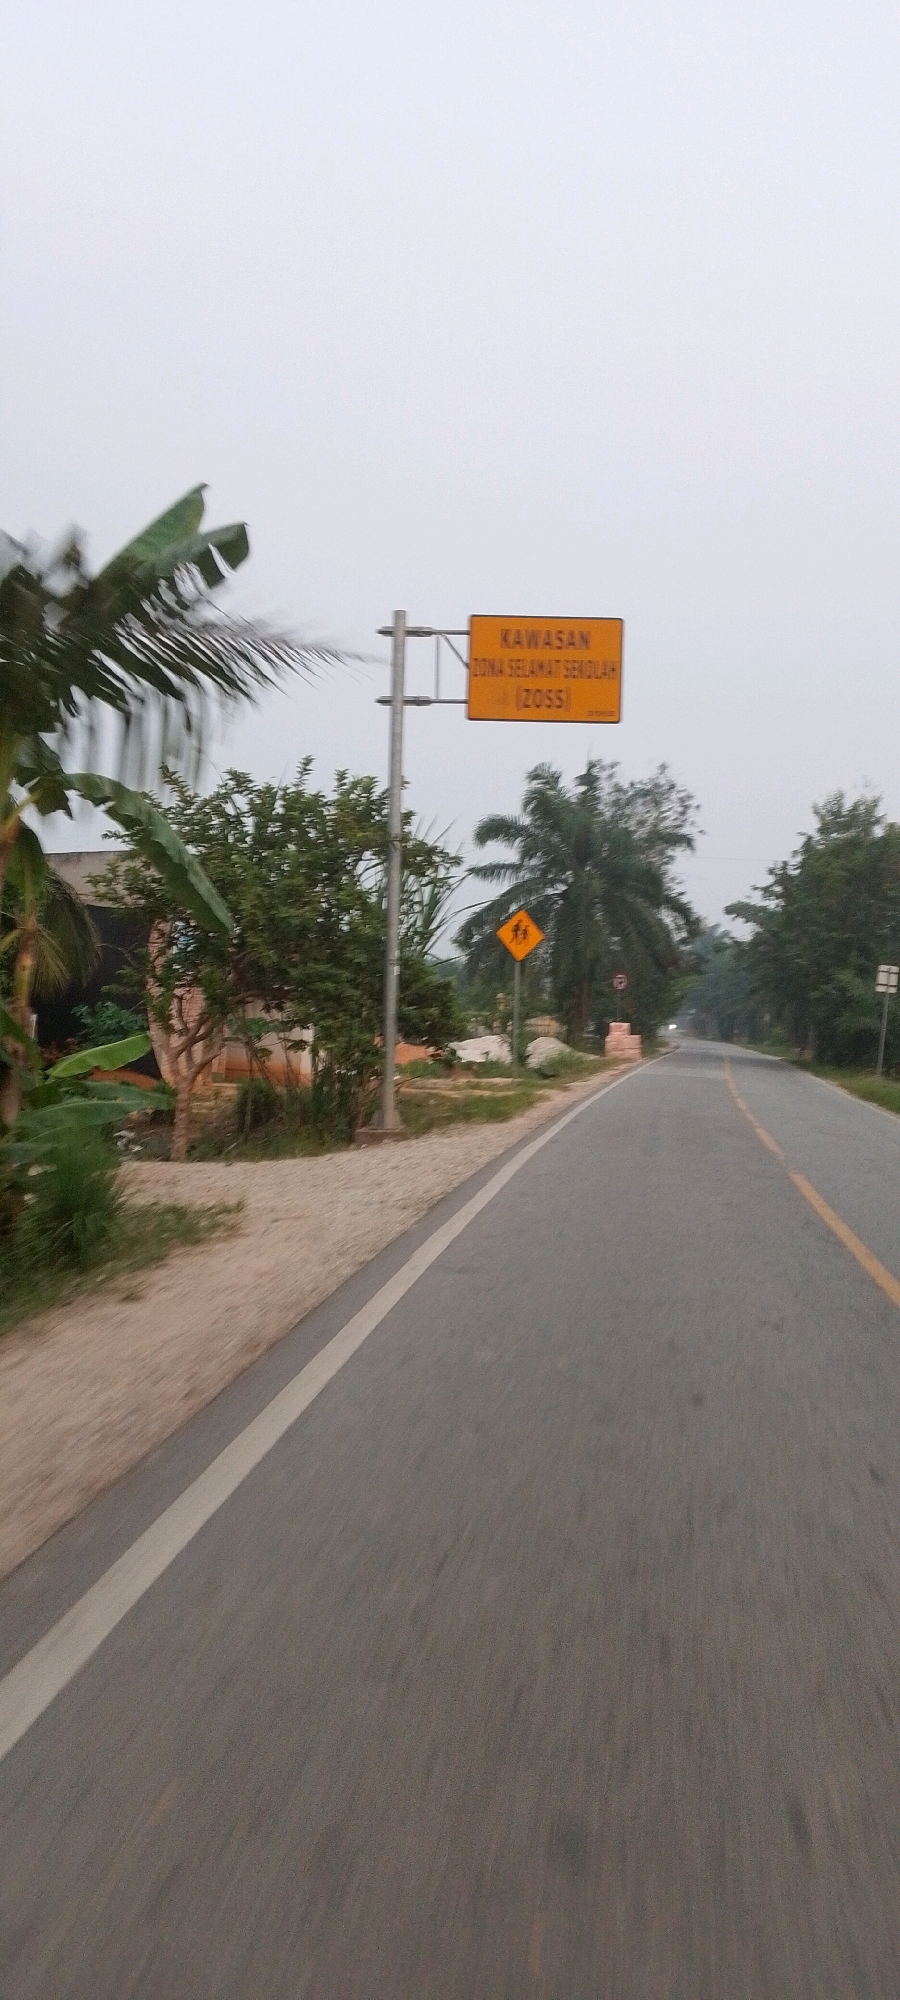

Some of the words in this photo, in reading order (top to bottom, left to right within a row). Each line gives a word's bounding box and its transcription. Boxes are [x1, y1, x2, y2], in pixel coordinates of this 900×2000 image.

[501, 628, 591, 650] KAWASAN
[472, 657, 504, 677] ZONA
[508, 658, 562, 679] SELAMAT
[563, 659, 619, 680] SEKOLAH
[516, 685, 571, 712] (ZOSS)
